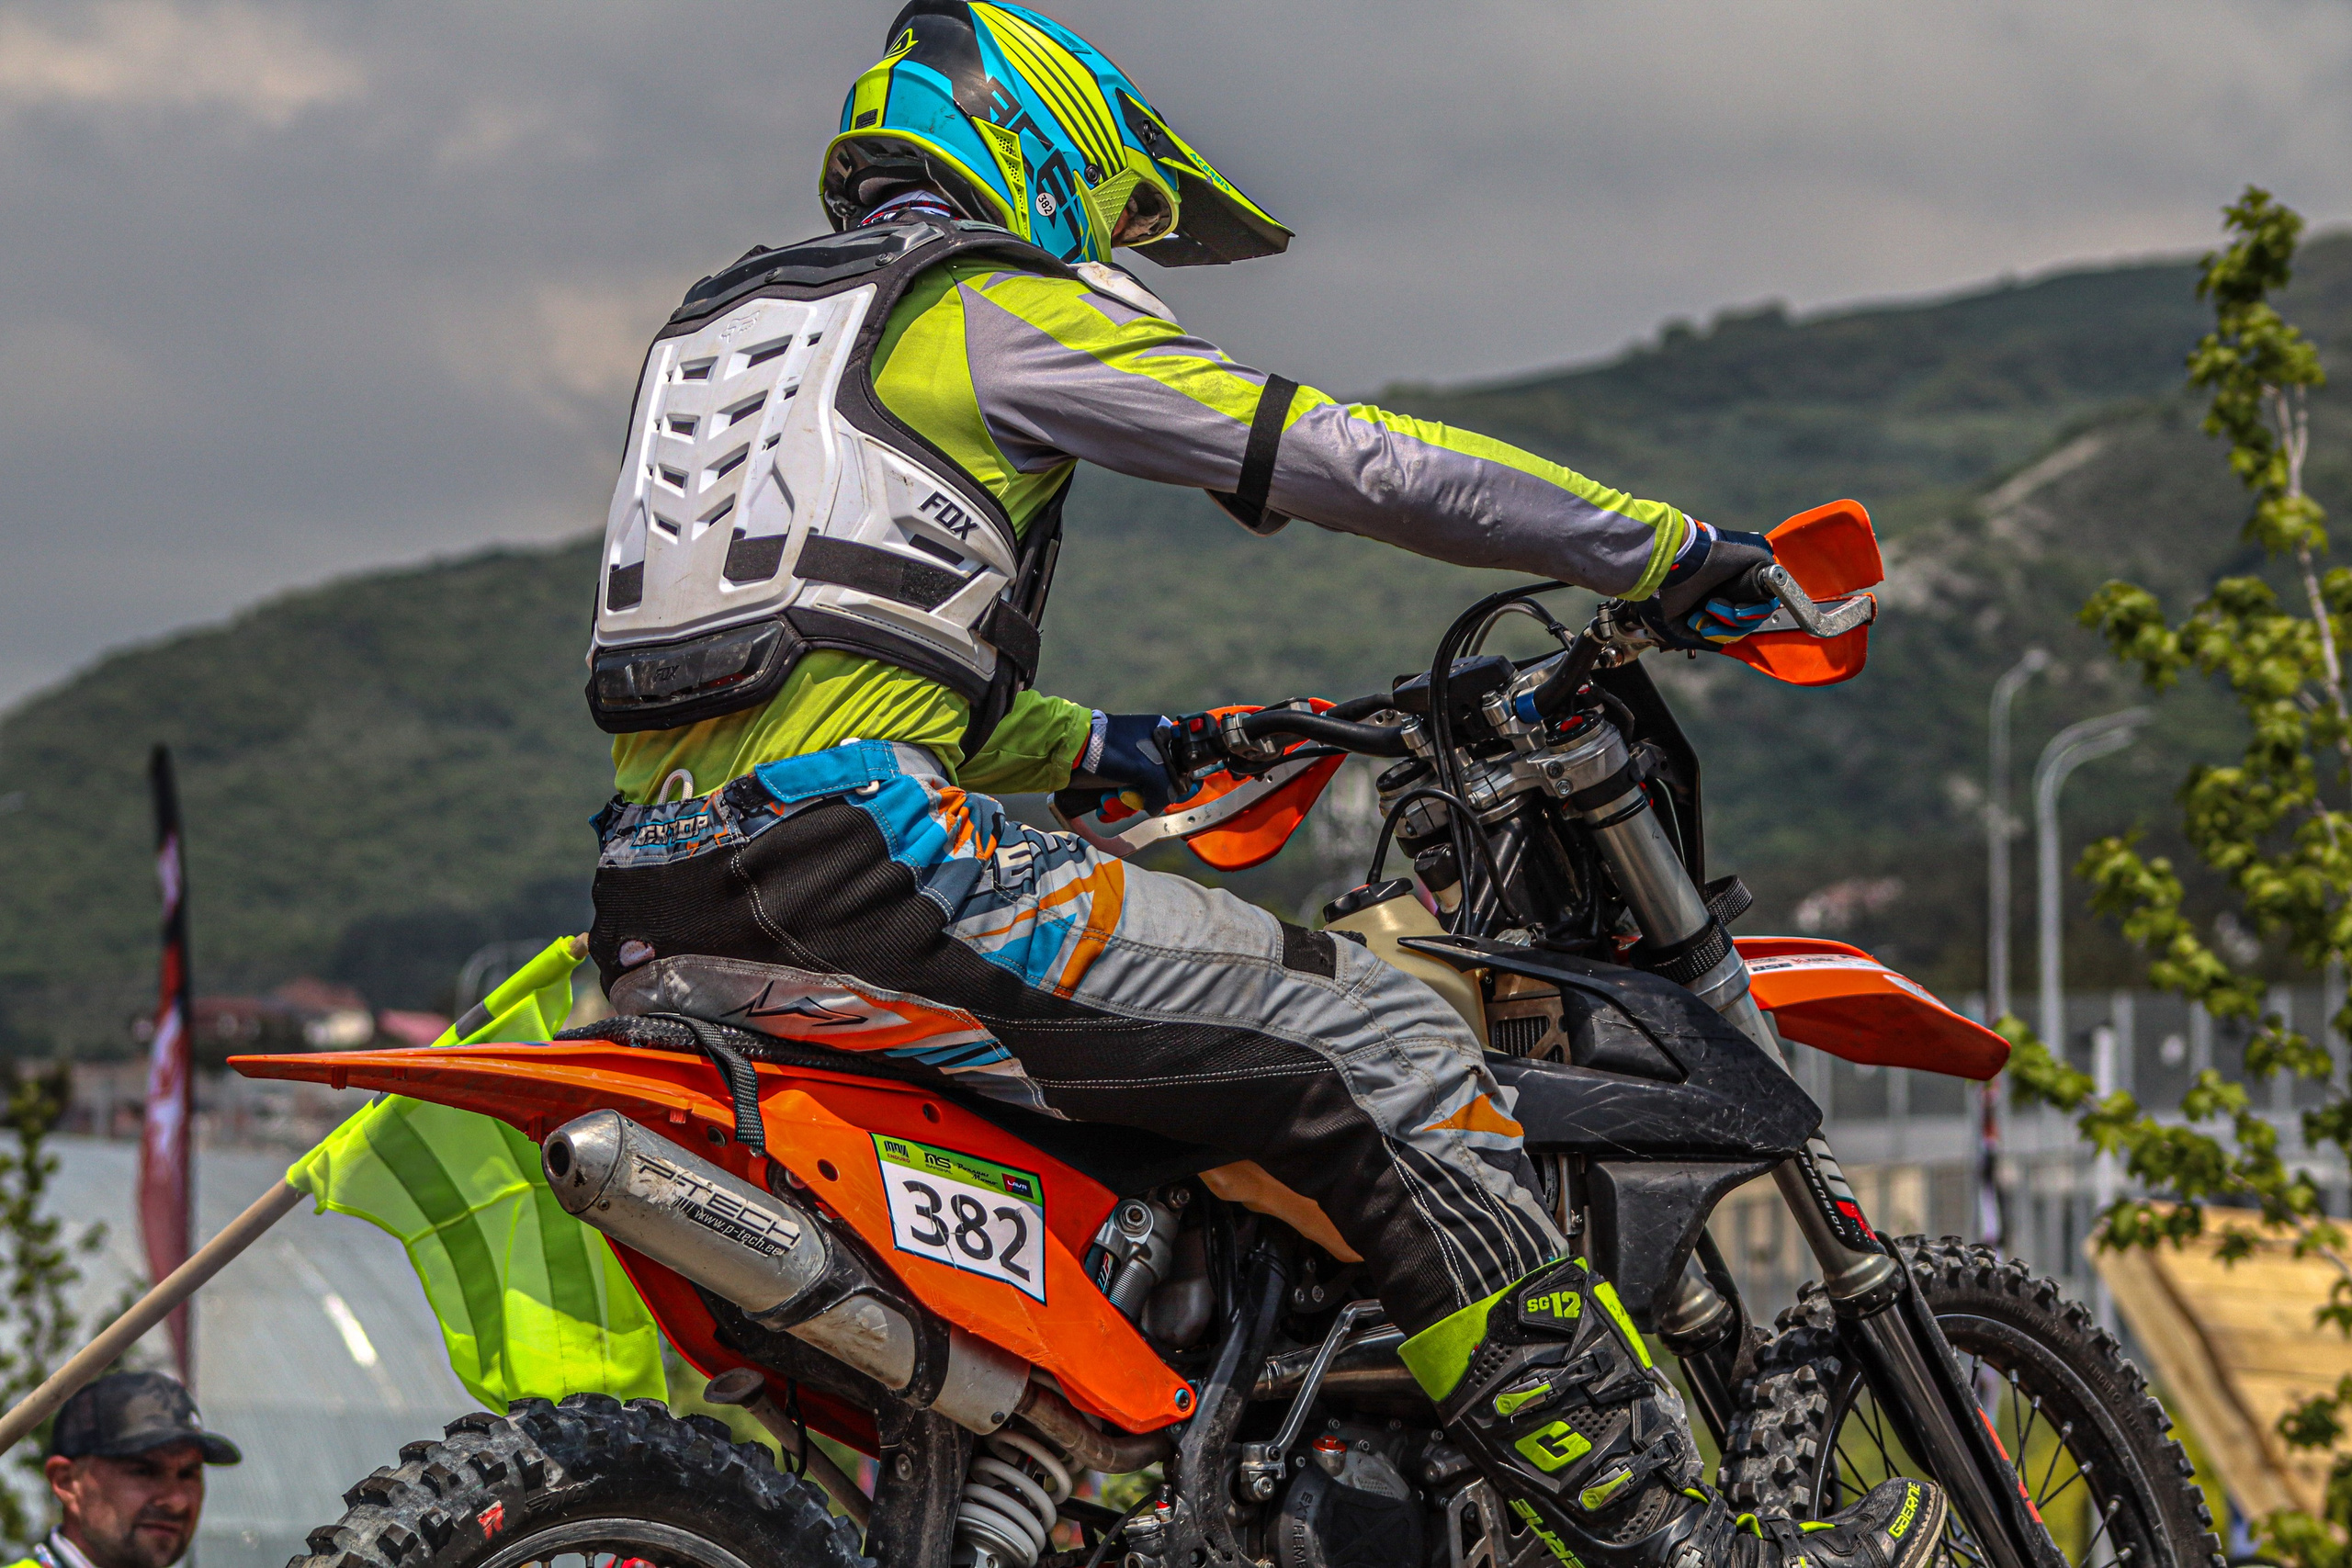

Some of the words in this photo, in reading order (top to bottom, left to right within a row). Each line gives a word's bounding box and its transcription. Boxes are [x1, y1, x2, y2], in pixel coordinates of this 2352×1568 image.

[1038, 195, 1053, 214] 382
[919, 491, 979, 541] FOX
[652, 665, 680, 682] FOX
[637, 1155, 800, 1246] P-TECH
[694, 1209, 784, 1256] www.p-tech.ee
[902, 1180, 1031, 1282] 382
[1889, 1482, 1920, 1539] GAERNE
